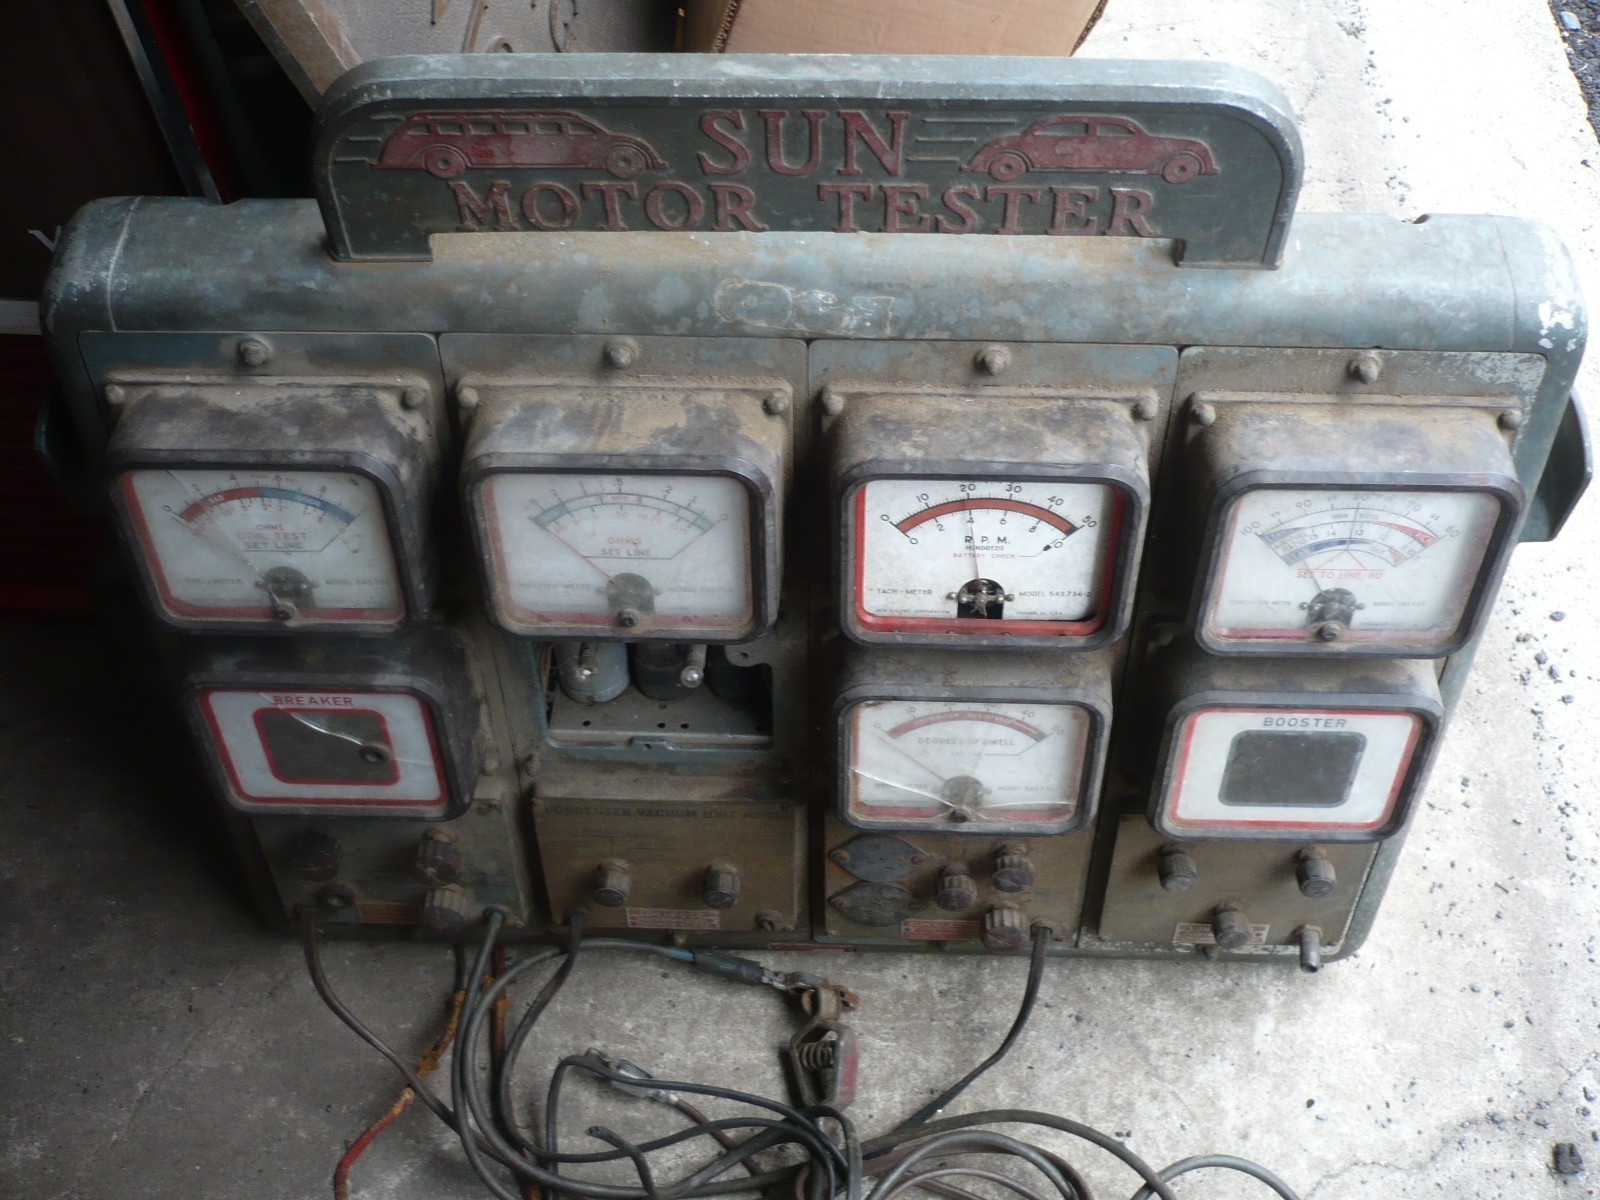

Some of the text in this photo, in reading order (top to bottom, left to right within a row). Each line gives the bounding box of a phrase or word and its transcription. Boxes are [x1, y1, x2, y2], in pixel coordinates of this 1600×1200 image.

[699, 108, 910, 177] SUN
[447, 179, 1159, 238] MOTOR TESTER
[959, 483, 976, 492] 20
[1005, 484, 1022, 493] 30
[916, 493, 929, 503] 10
[1048, 495, 1064, 506] 40
[1295, 499, 1312, 508] 90
[1082, 515, 1097, 528] 50
[936, 524, 945, 532] 2
[1240, 521, 1260, 536] 100
[1445, 525, 1460, 538] 60
[274, 532, 307, 541] TEST
[607, 537, 642, 545] OHMS
[909, 537, 919, 545] 0
[244, 541, 268, 549] SET
[1320, 571, 1334, 579] TO
[1338, 571, 1360, 580] LINE
[273, 695, 354, 707] BREAKER
[1020, 709, 1036, 718] 40
[1264, 716, 1348, 728] BOOSTER
[918, 737, 963, 745] DEGREES
[982, 738, 1014, 746] DWELL
[637, 808, 697, 818] VACUUM
